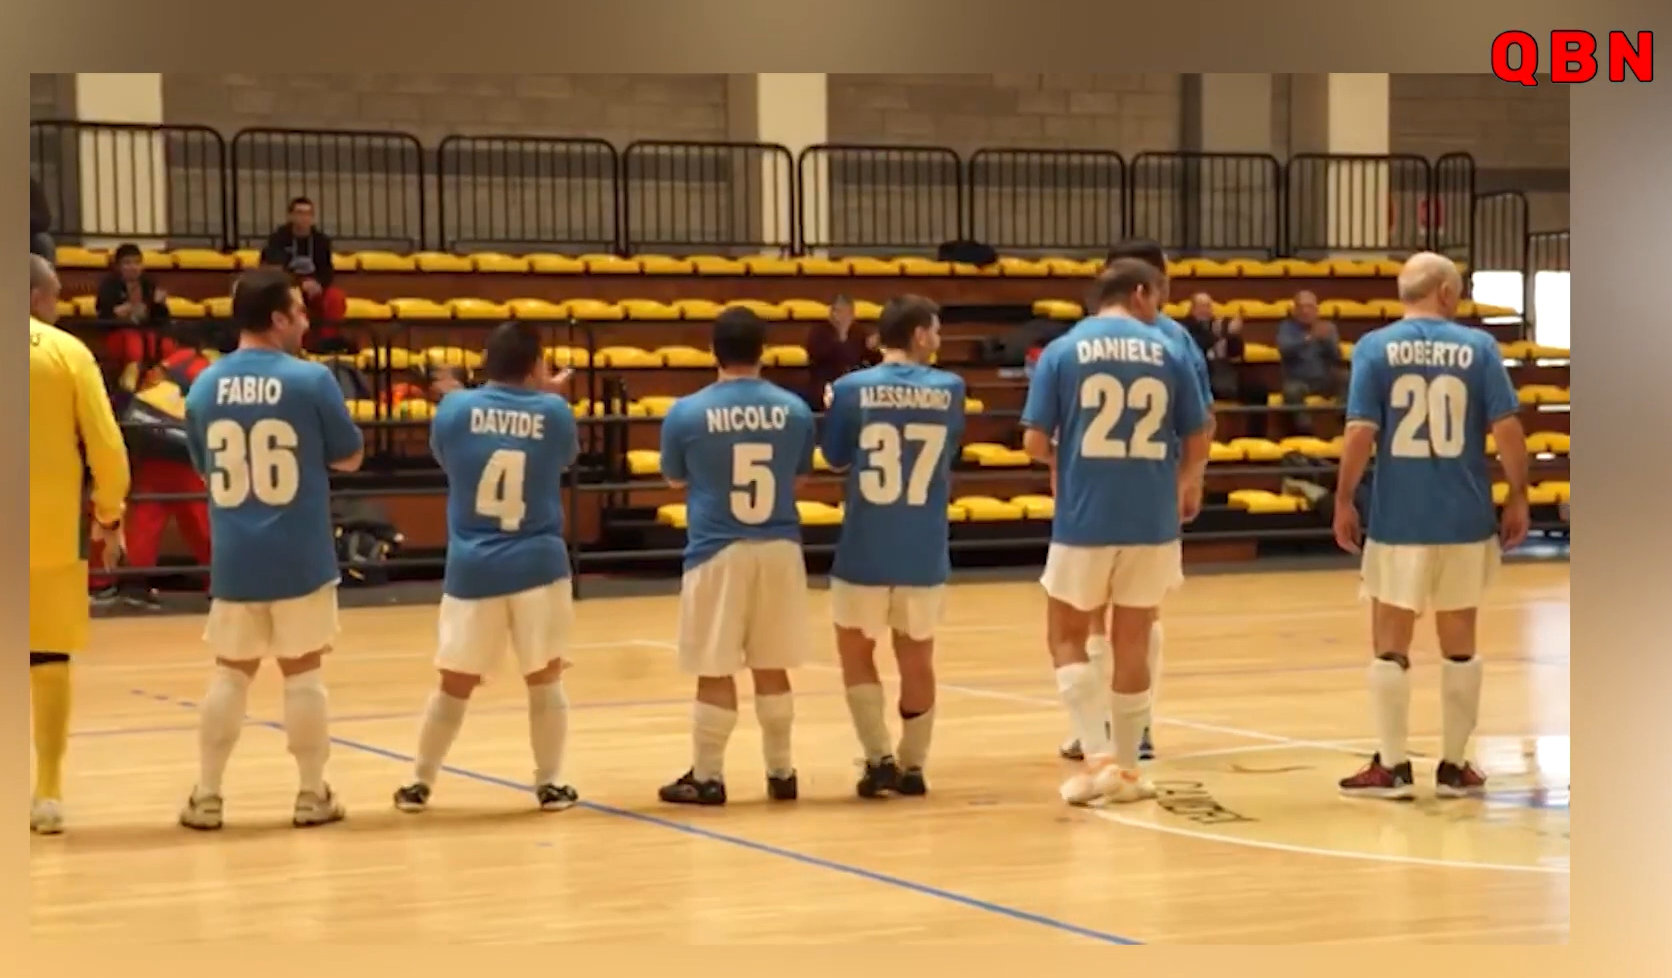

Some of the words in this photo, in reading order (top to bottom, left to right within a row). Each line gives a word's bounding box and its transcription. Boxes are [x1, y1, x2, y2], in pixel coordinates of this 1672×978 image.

[1076, 337, 1164, 366] DANIELE
[1386, 340, 1473, 369] ROBERTO
[216, 376, 282, 405] FABIO
[706, 405, 789, 432] NICOLO'
[860, 385, 951, 411] ALESSANDRO
[1080, 372, 1168, 460] 22
[1390, 373, 1468, 458] 20
[470, 408, 545, 440] DAVIDE
[206, 418, 299, 508] 36
[475, 449, 527, 531] 4
[730, 443, 776, 525] 5
[859, 422, 947, 506] 37
